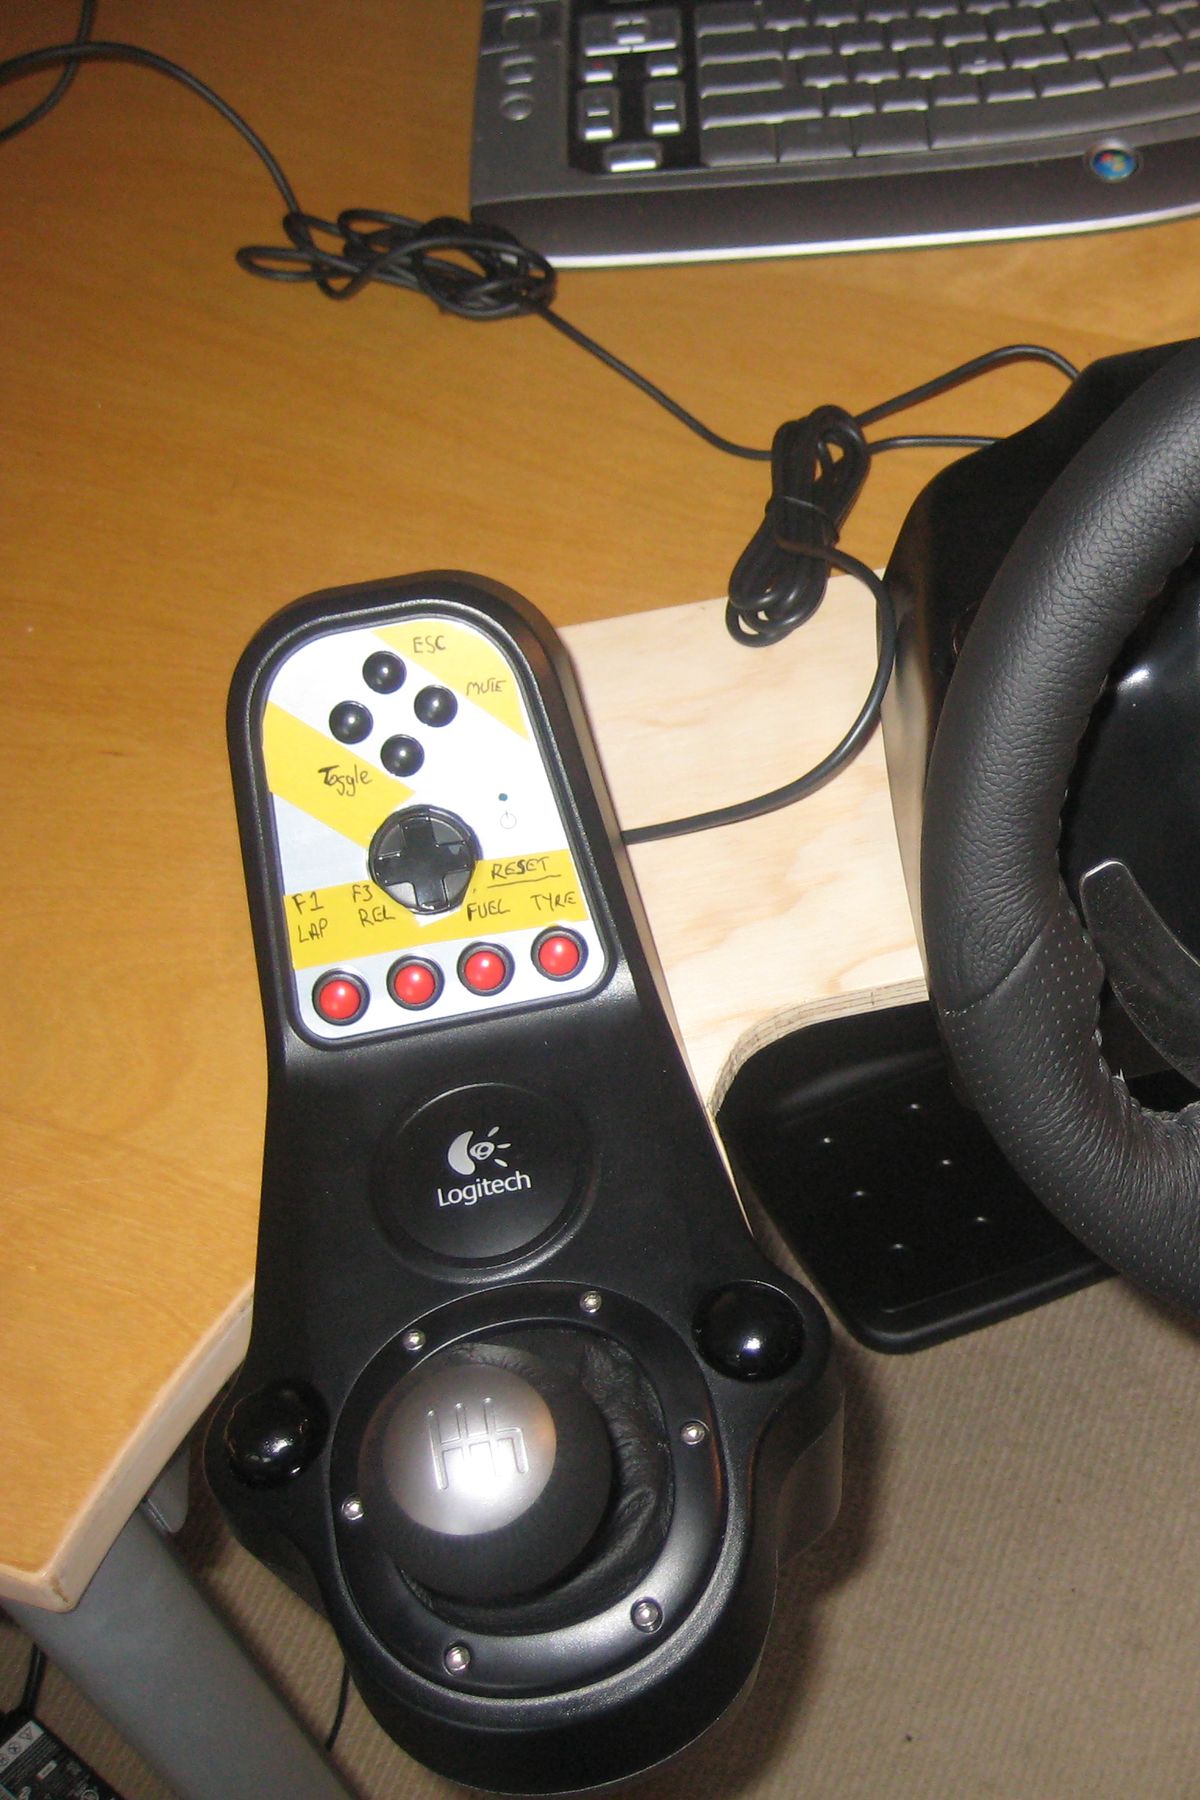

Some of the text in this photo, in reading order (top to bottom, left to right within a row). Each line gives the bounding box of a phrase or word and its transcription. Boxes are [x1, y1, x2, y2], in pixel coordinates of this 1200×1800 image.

[412, 634, 446, 655] ESC
[466, 676, 507, 697] MUTE
[317, 763, 374, 798] Toggle
[490, 855, 550, 881] RESET
[291, 891, 325, 916] F1
[351, 883, 374, 904] F3
[529, 890, 577, 913] TYRE
[358, 904, 397, 929] REL
[466, 898, 512, 922] FUEL
[297, 917, 329, 944] LAP
[437, 1169, 533, 1208] Logitech
